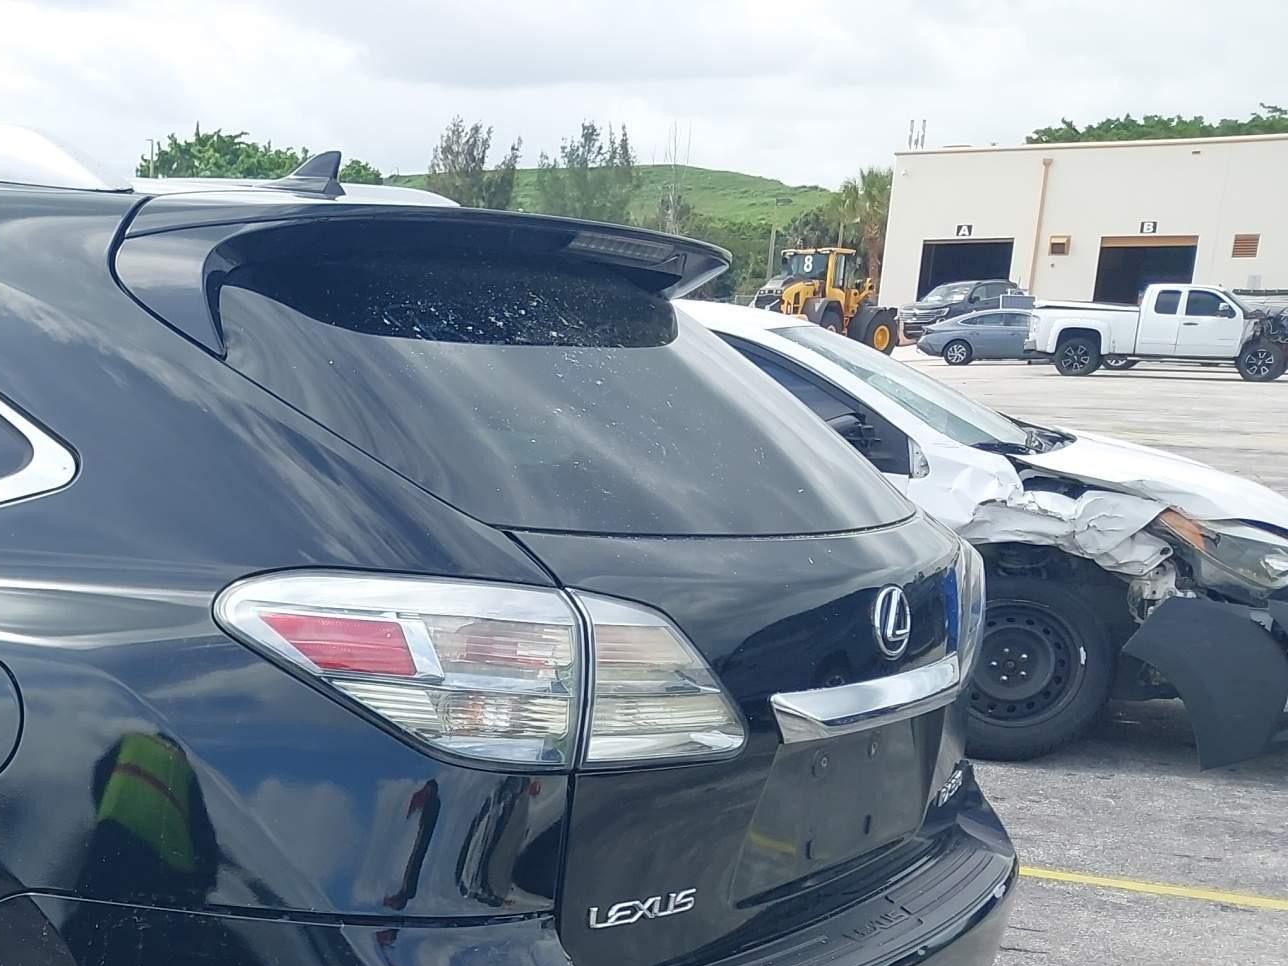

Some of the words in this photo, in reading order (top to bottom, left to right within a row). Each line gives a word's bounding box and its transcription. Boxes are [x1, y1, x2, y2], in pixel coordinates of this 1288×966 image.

[958, 225, 970, 237] A
[1143, 222, 1154, 234] B
[803, 254, 813, 273] 8
[589, 888, 697, 929] LEXUS
